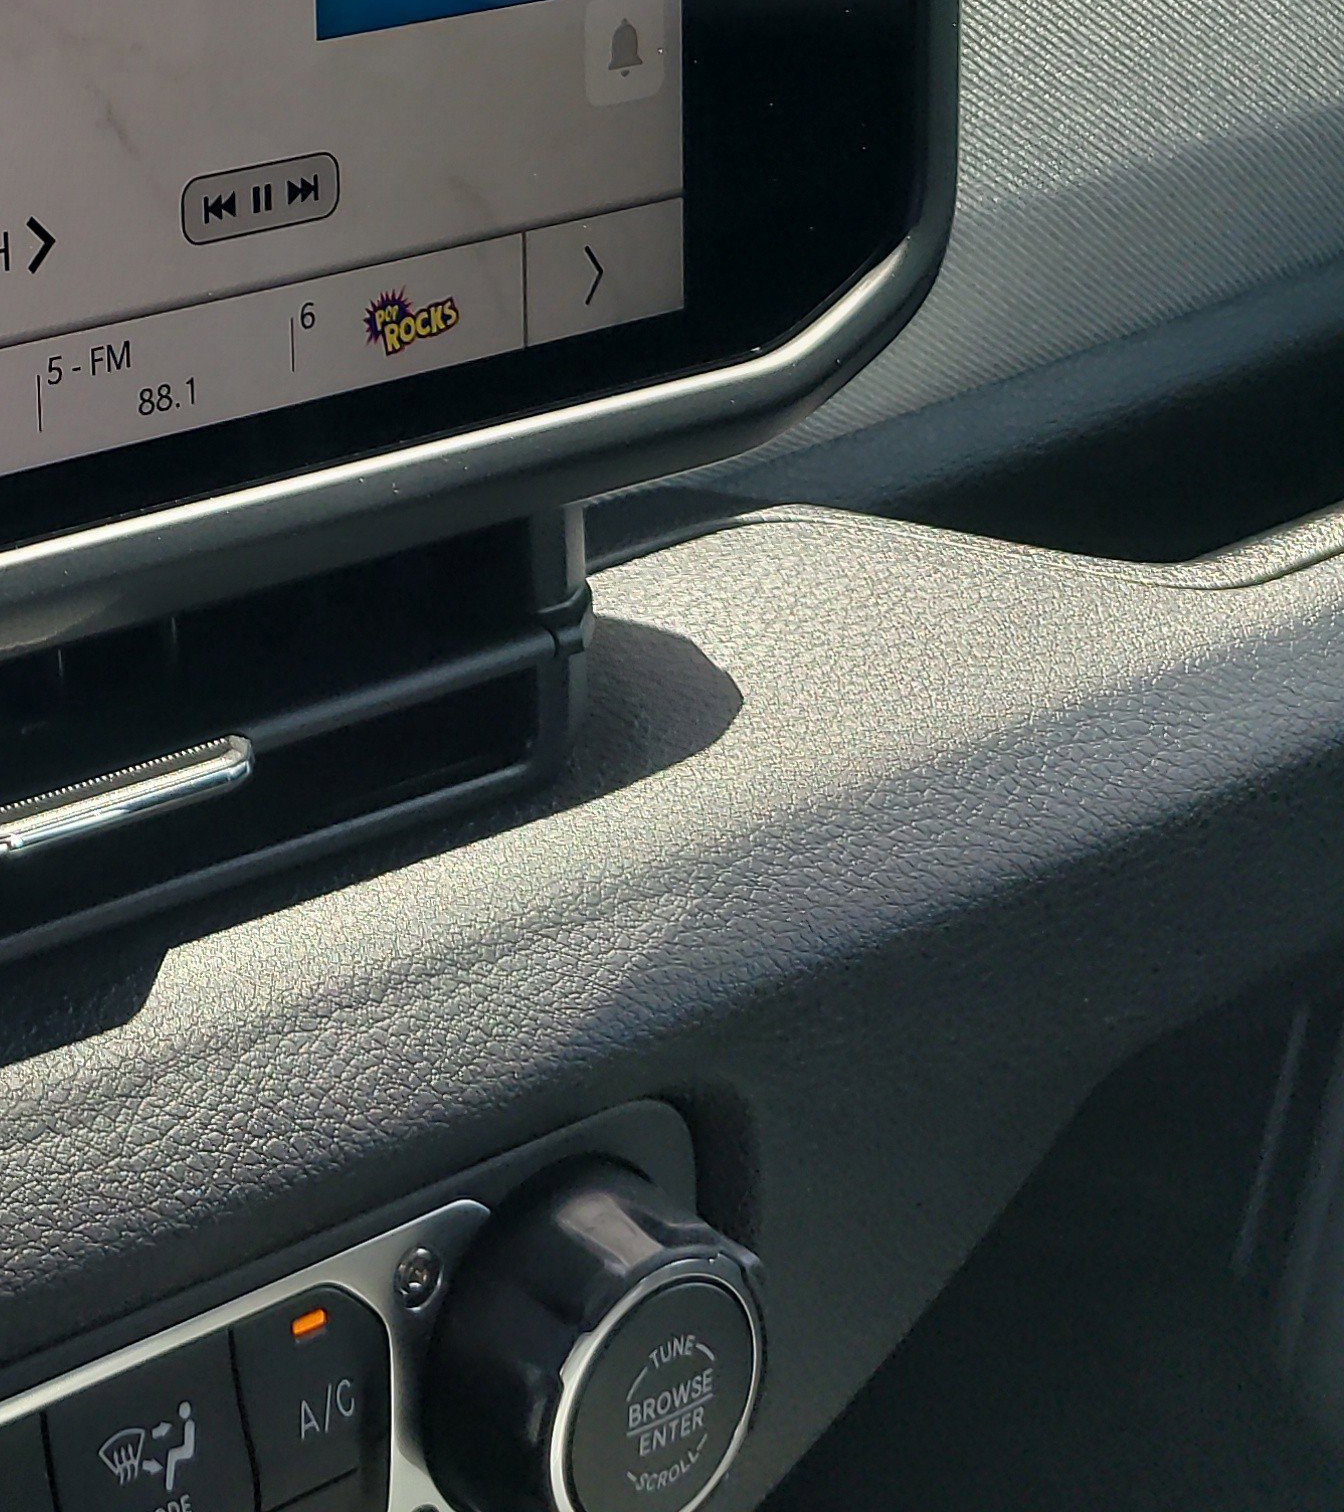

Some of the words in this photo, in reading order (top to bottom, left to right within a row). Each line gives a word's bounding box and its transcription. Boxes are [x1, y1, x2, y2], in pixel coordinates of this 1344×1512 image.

[299, 300, 316, 331] 6
[384, 300, 458, 353] ROCKS
[46, 355, 64, 386] 5
[89, 339, 132, 377] FM
[137, 377, 199, 418] 88.1
[648, 1334, 696, 1369] TUNE
[299, 1379, 356, 1442] A/C
[628, 1368, 714, 1428] BROWSE
[639, 1406, 705, 1457] ENTER
[633, 1450, 700, 1491] SCROLL
